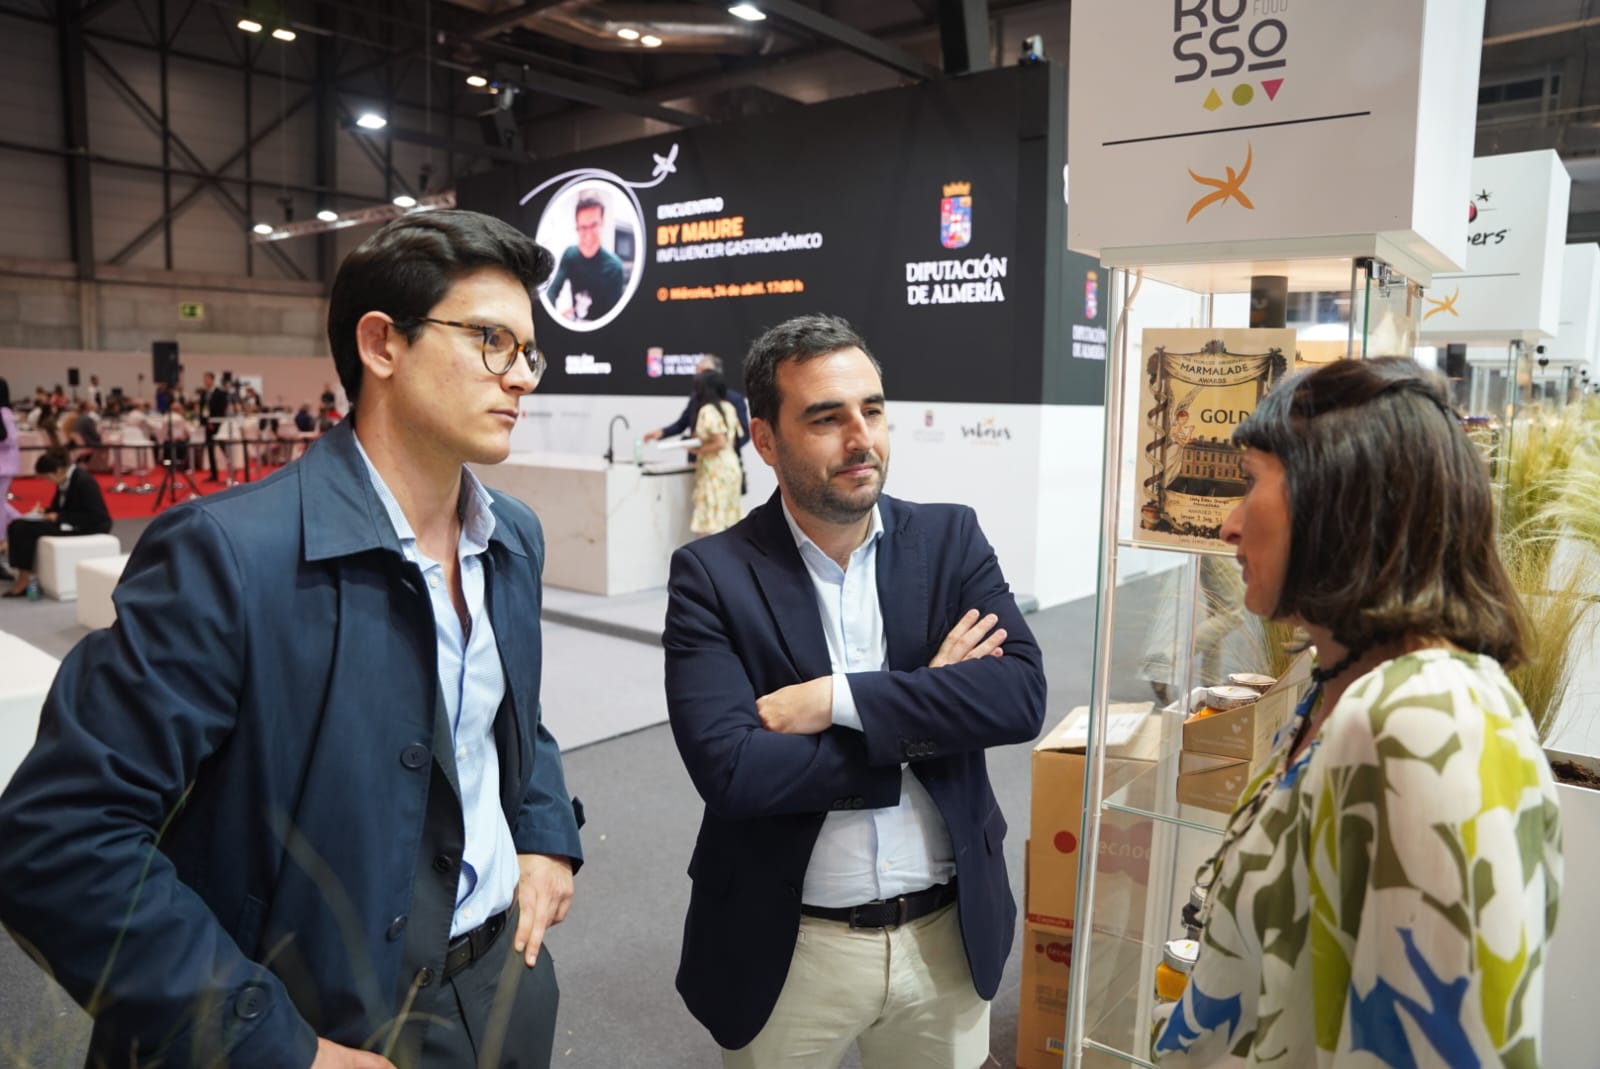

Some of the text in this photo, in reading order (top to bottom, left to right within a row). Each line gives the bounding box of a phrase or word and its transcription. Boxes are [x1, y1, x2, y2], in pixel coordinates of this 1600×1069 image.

[656, 216, 744, 245] BY MAURE
[1467, 229, 1508, 246] ers
[656, 232, 823, 262] INFLUENCER GASTRONÓMICO
[906, 253, 1008, 282] DIPUTACIÓN
[907, 277, 1005, 305] DE ALMERÍA
[1180, 362, 1249, 376] MARMALADE
